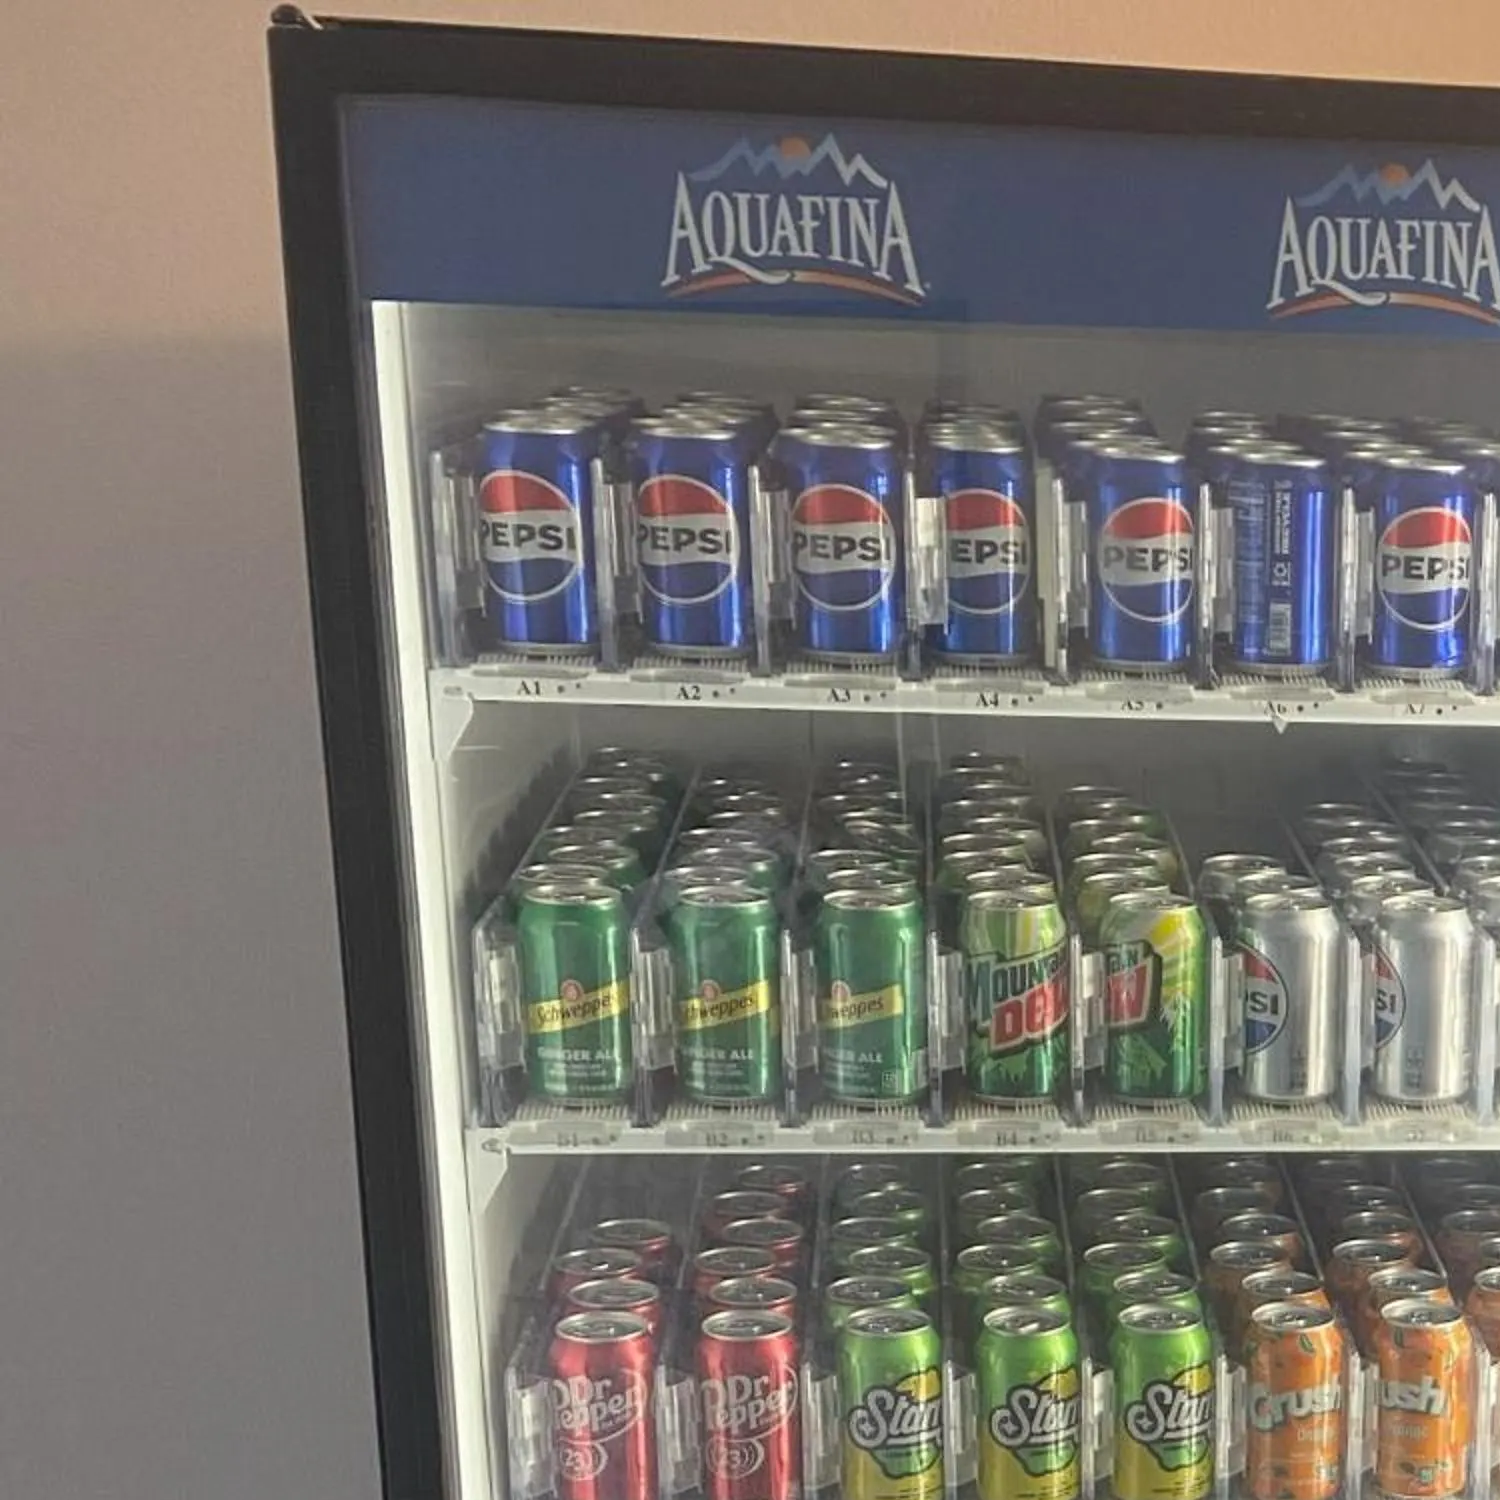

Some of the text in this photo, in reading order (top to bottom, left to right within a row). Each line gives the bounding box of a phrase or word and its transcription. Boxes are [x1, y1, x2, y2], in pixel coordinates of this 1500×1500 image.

[661, 171, 925, 296] AQUAFINA
[791, 530, 891, 563] PEPSI
[950, 538, 1028, 566] EPSI
[517, 680, 542, 696] A1
[677, 685, 701, 700] A2
[828, 688, 851, 703] A3
[976, 693, 1000, 708] A4
[569, 1375, 612, 1401] Dr
[727, 1375, 770, 1401] Dr
